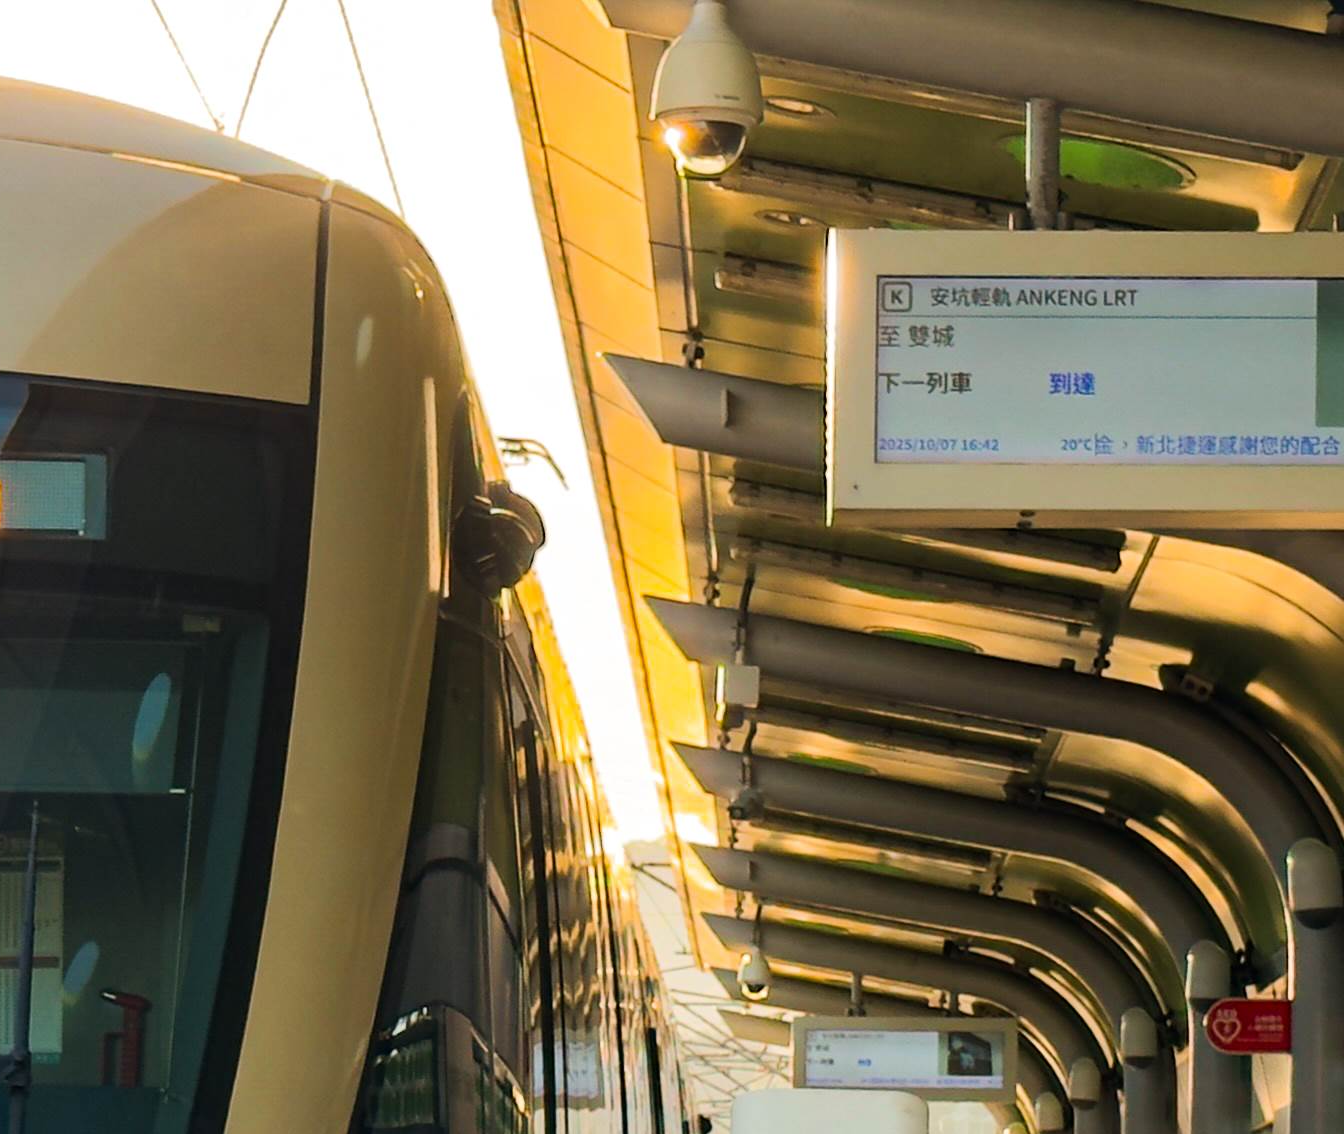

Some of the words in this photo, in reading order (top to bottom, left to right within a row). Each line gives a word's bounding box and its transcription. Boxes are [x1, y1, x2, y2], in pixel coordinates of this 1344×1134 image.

[890, 289, 904, 305] K
[930, 287, 1012, 308] 安坑輕軌
[1016, 289, 1098, 307] ANKENG
[1103, 289, 1139, 306] LRT
[879, 325, 901, 348] 至
[908, 324, 956, 348] 雙城
[879, 372, 973, 395] 下一列車
[1048, 372, 1097, 396] 到達
[879, 438, 957, 452] 2025/10/07
[960, 438, 1000, 452] 16:42
